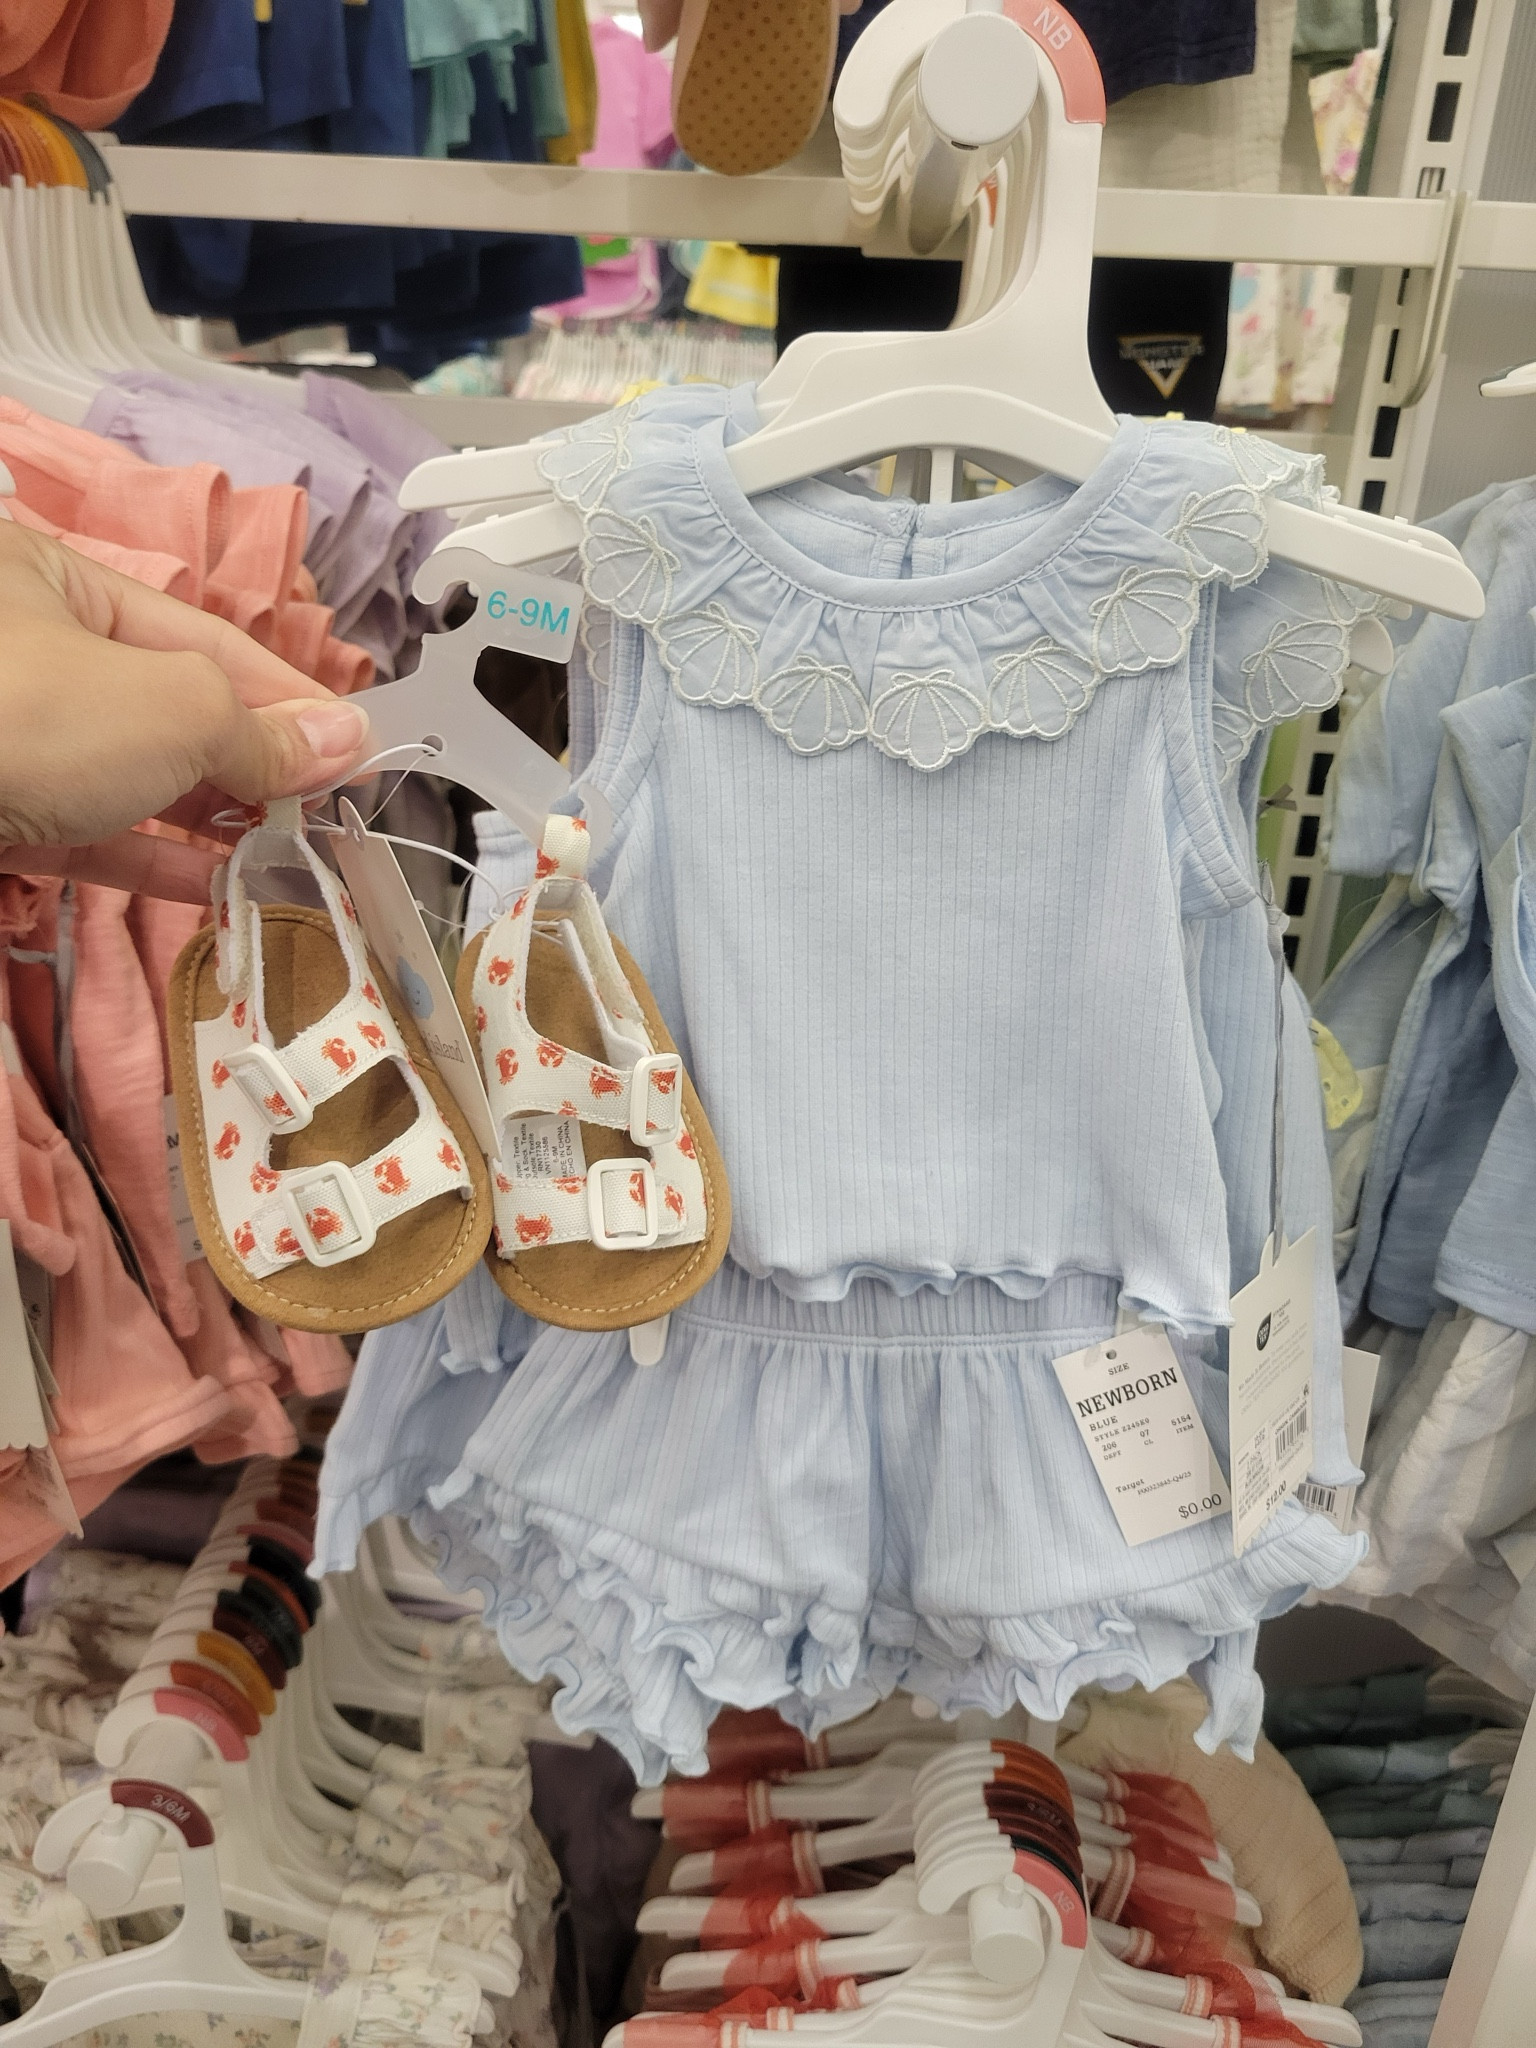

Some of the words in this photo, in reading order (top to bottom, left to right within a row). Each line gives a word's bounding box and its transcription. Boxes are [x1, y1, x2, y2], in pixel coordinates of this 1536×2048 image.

[1033, 6, 1073, 50] NB
[487, 590, 570, 636] 6-9M
[536, 1141, 544, 1172] RN17730
[566, 1145, 573, 1156] EN
[1107, 1362, 1130, 1376] SIZE
[1076, 1367, 1178, 1418] NEWBORN
[1089, 1415, 1118, 1432] BLUE
[1094, 1428, 1120, 1443] STYLE
[1102, 1442, 1118, 1452] 206
[1116, 1479, 1145, 1494] Target
[1266, 1480, 1286, 1511] $12.00
[1178, 1494, 1222, 1519] $0.00
[151, 1793, 191, 1824] 3/6M
[1053, 1890, 1075, 1916] NB
